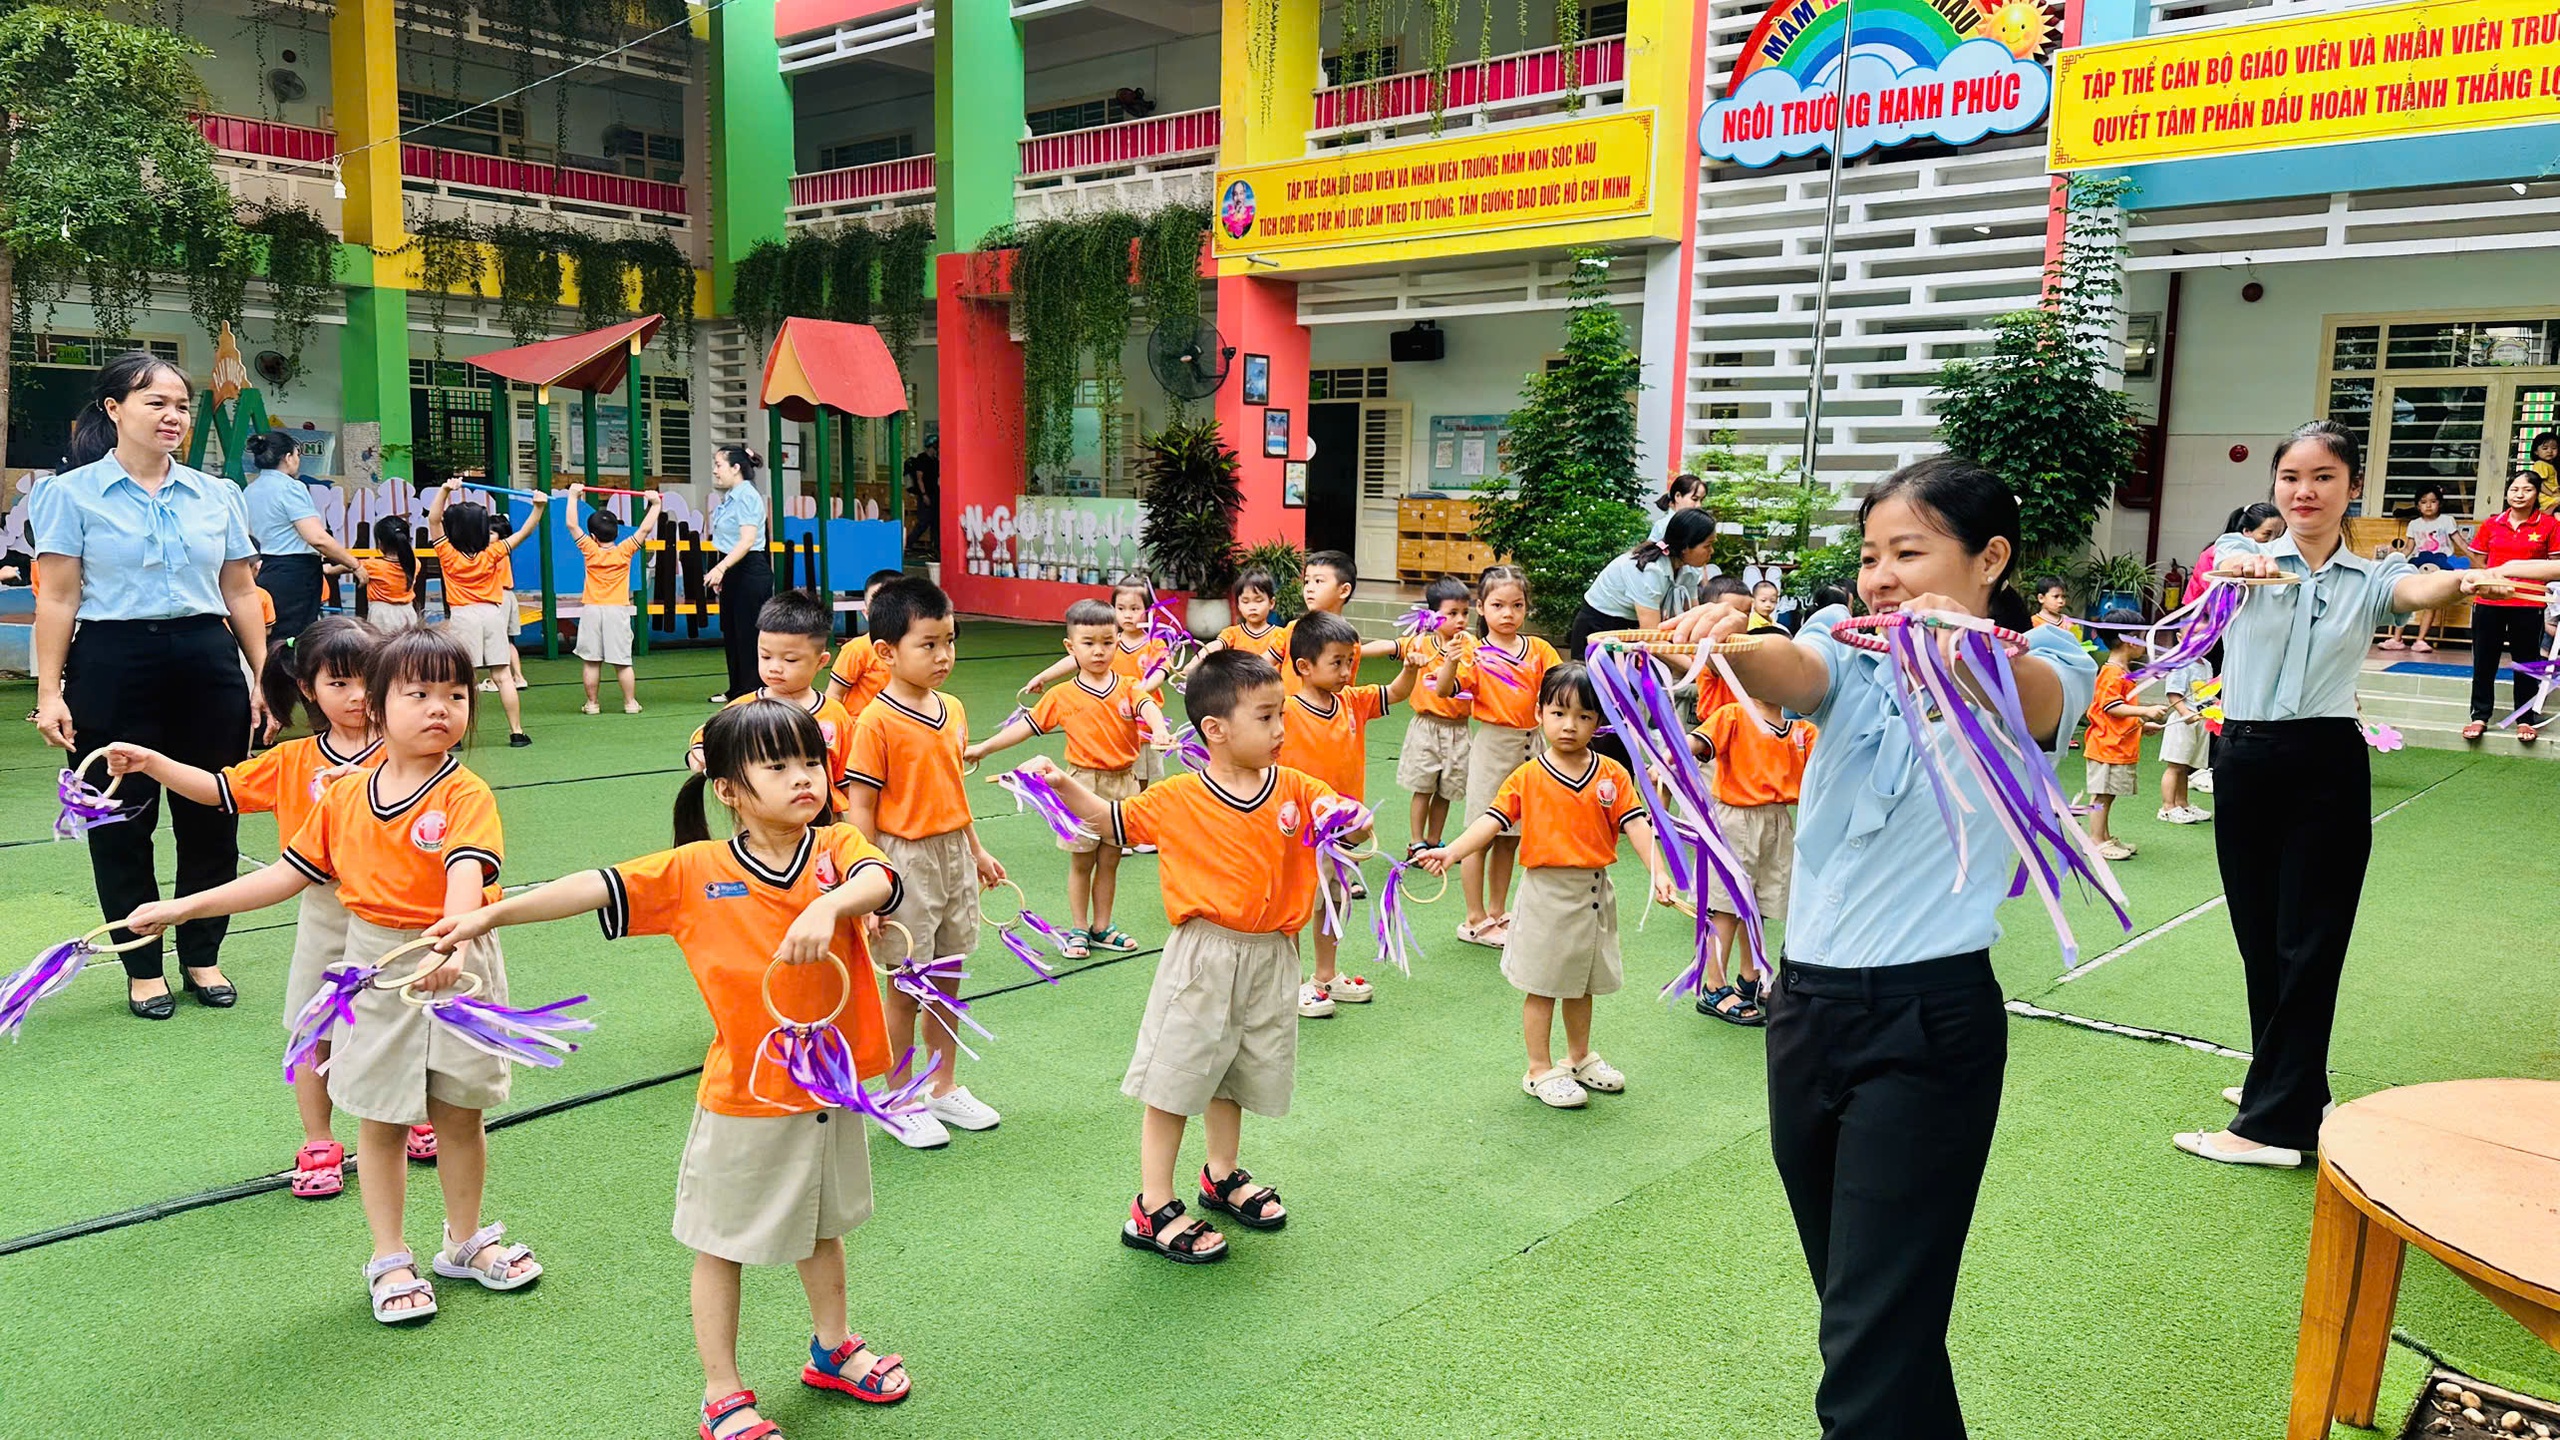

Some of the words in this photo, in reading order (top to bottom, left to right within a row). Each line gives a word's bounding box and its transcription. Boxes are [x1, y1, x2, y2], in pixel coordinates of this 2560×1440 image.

[1762, 0, 1817, 62] MẦM
[2082, 68, 2116, 104] TẬP
[2122, 56, 2157, 95] THỂ
[2161, 57, 2200, 91] CÁN
[2206, 51, 2233, 88] BỘ
[2240, 45, 2288, 82] GIÁO
[2295, 38, 2342, 74] VIÊN
[2349, 33, 2375, 67] VÀ
[2383, 25, 2444, 63] NHÂN
[2452, 17, 2503, 55] VIÊN
[2511, 8, 2560, 48] TRƯ
[1722, 100, 1773, 143] NGÔI
[1781, 91, 1871, 136] TRƯỜNG
[1878, 82, 1944, 129] HẠNH
[1951, 70, 2021, 116] PHÚC
[2093, 105, 2151, 146] QUYẾT
[2156, 105, 2196, 137] TÂM
[2202, 93, 2255, 133] PHẤN
[2261, 87, 2303, 126] ĐẤU
[2309, 85, 2368, 121] HOÀN
[2375, 75, 2448, 114] THÀNH
[2456, 63, 2532, 105] THẮNG
[1259, 215, 1277, 237] TÍCH
[1280, 212, 1296, 237] CỰC
[1298, 213, 1315, 236] HỌC
[1348, 205, 1364, 231] LỰC
[1386, 202, 1408, 224] THEO
[1410, 198, 1423, 222] TƯ
[1459, 188, 1478, 216] TẤM
[1481, 187, 1514, 214] GƯƠNG
[1517, 187, 1537, 213] ĐẠO
[1540, 181, 1561, 206] ĐỨC
[1563, 173, 1578, 204] HỒ
[1581, 175, 1600, 202] CHÍ
[1602, 175, 1631, 200] MINH
[1287, 179, 1302, 205] TẬP
[1304, 172, 1319, 199] THỂ
[1376, 167, 1395, 191] VIÊN
[1397, 164, 1408, 188] VÀ
[1411, 161, 1435, 186] NHÂN
[1438, 158, 1458, 183] VIÊN
[1501, 145, 1525, 175] MẦM
[1528, 148, 1549, 171] NON
[1551, 142, 1572, 169] SÓC
[1575, 138, 1597, 165] NÂU
